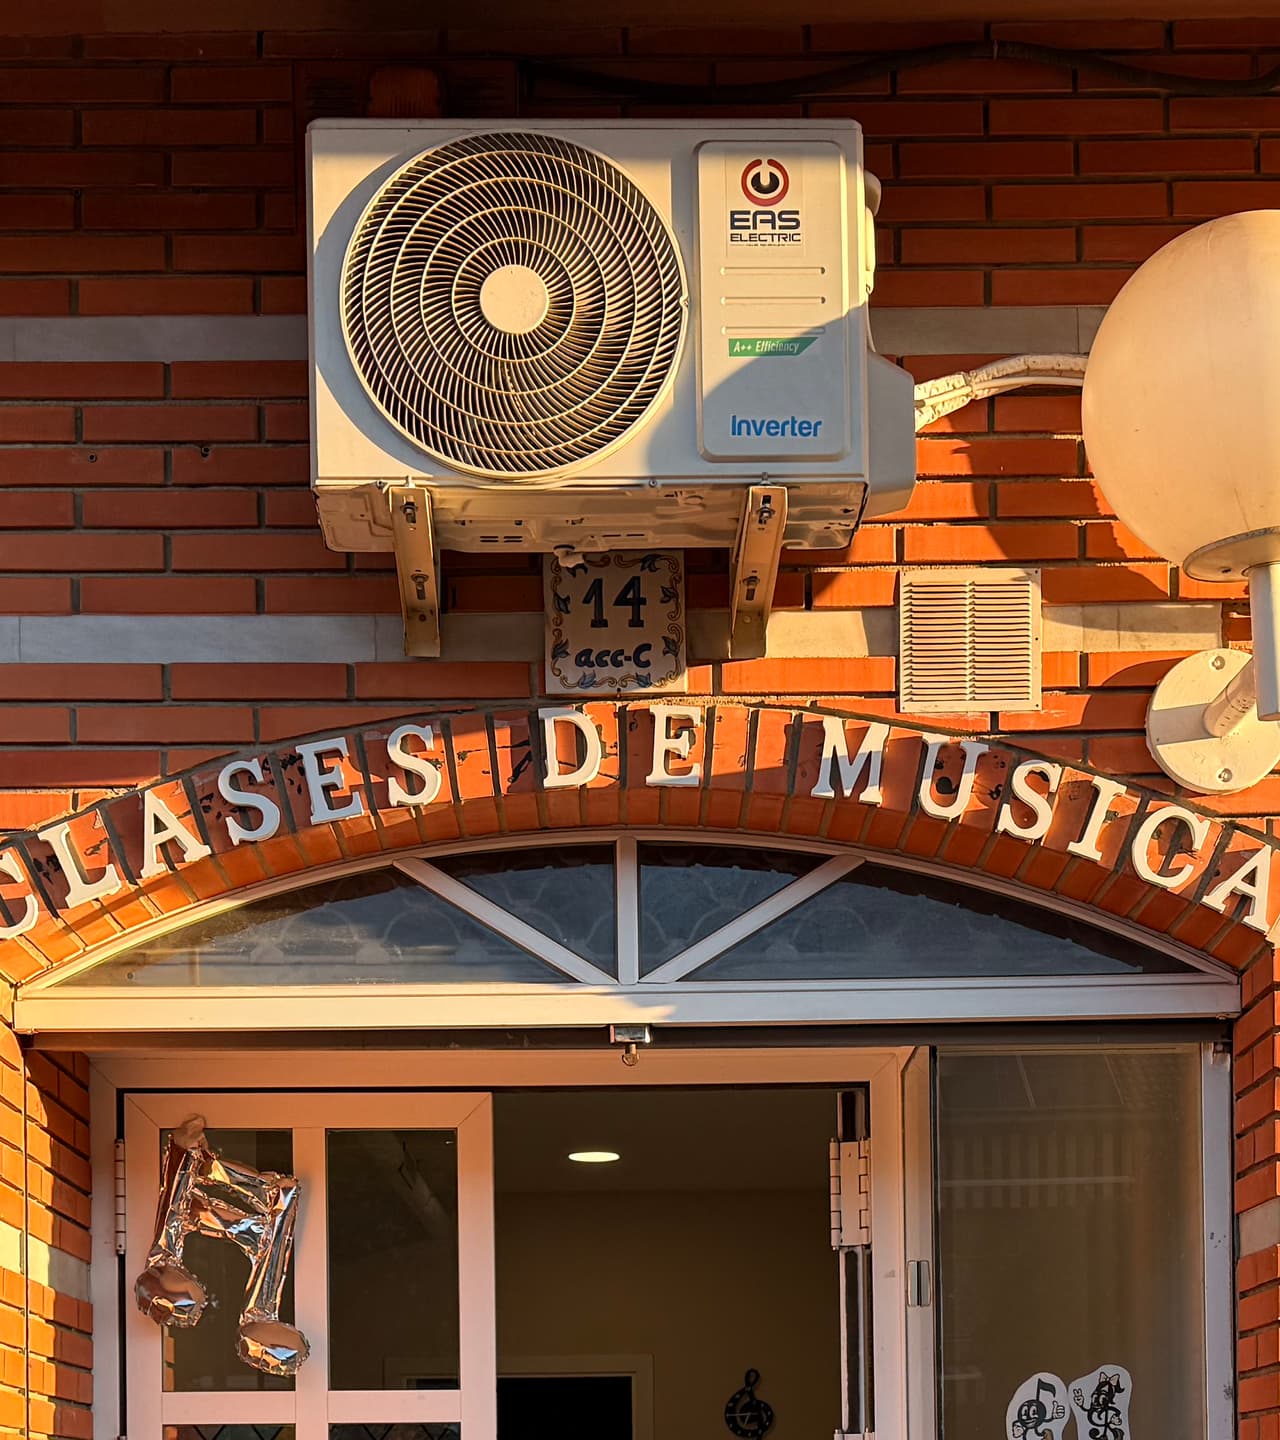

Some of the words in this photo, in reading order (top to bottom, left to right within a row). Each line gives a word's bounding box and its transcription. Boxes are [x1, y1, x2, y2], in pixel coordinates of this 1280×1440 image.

[730, 210, 800, 230] EAS
[730, 233, 801, 242] ELECTRIC
[733, 341, 752, 353] A++
[755, 340, 800, 353] Efficiency
[731, 415, 822, 437] Inverter
[582, 575, 647, 628] 14
[538, 705, 703, 790] DE
[810, 716, 1273, 935] MUSICA
